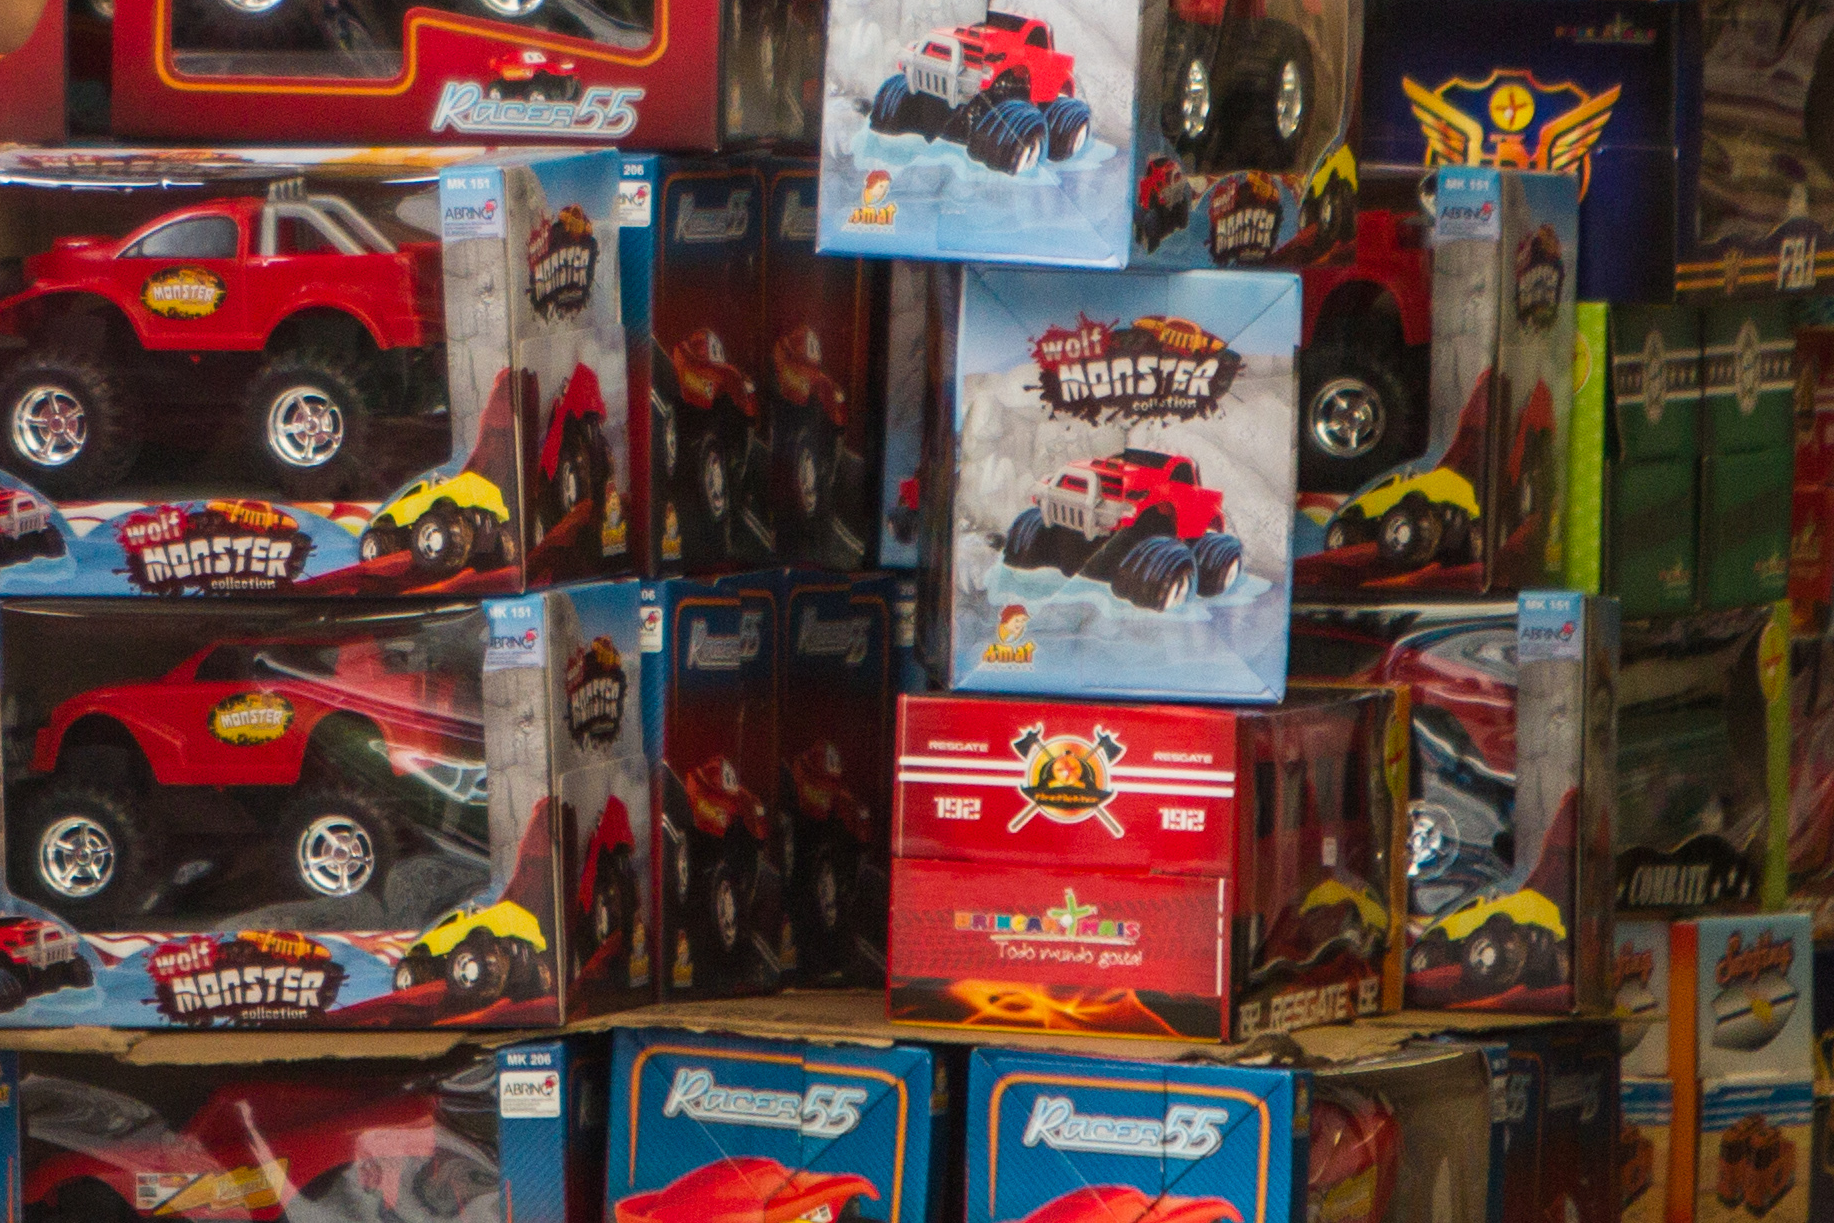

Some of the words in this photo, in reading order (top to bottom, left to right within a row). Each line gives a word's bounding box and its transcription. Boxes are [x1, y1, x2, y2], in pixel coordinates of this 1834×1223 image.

[622, 163, 645, 177] 206
[446, 177, 466, 190] MK
[469, 178, 491, 190] 151
[152, 284, 216, 303] MONSTER
[1040, 326, 1104, 364] wolf
[1056, 355, 1222, 405] MONSTER
[125, 509, 182, 547] wolf
[140, 535, 294, 585] MONSTER
[209, 575, 278, 590] collection
[640, 588, 656, 602] 06
[510, 606, 532, 619] 151
[219, 709, 284, 729] MONSTER
[928, 739, 989, 754] RESGATE
[1152, 751, 1214, 765] RESGATE
[934, 796, 982, 821] 192
[1158, 806, 1206, 832] 192
[954, 911, 1060, 934] BRINCAR
[1078, 917, 1142, 942] MAIS
[154, 939, 212, 977] wolf
[995, 940, 1037, 961] Todo
[1039, 946, 1095, 964] mundo
[171, 964, 326, 1015] MONSTER
[240, 1005, 309, 1021] collection
[506, 1053, 528, 1067] MK
[529, 1053, 552, 1067] 206
